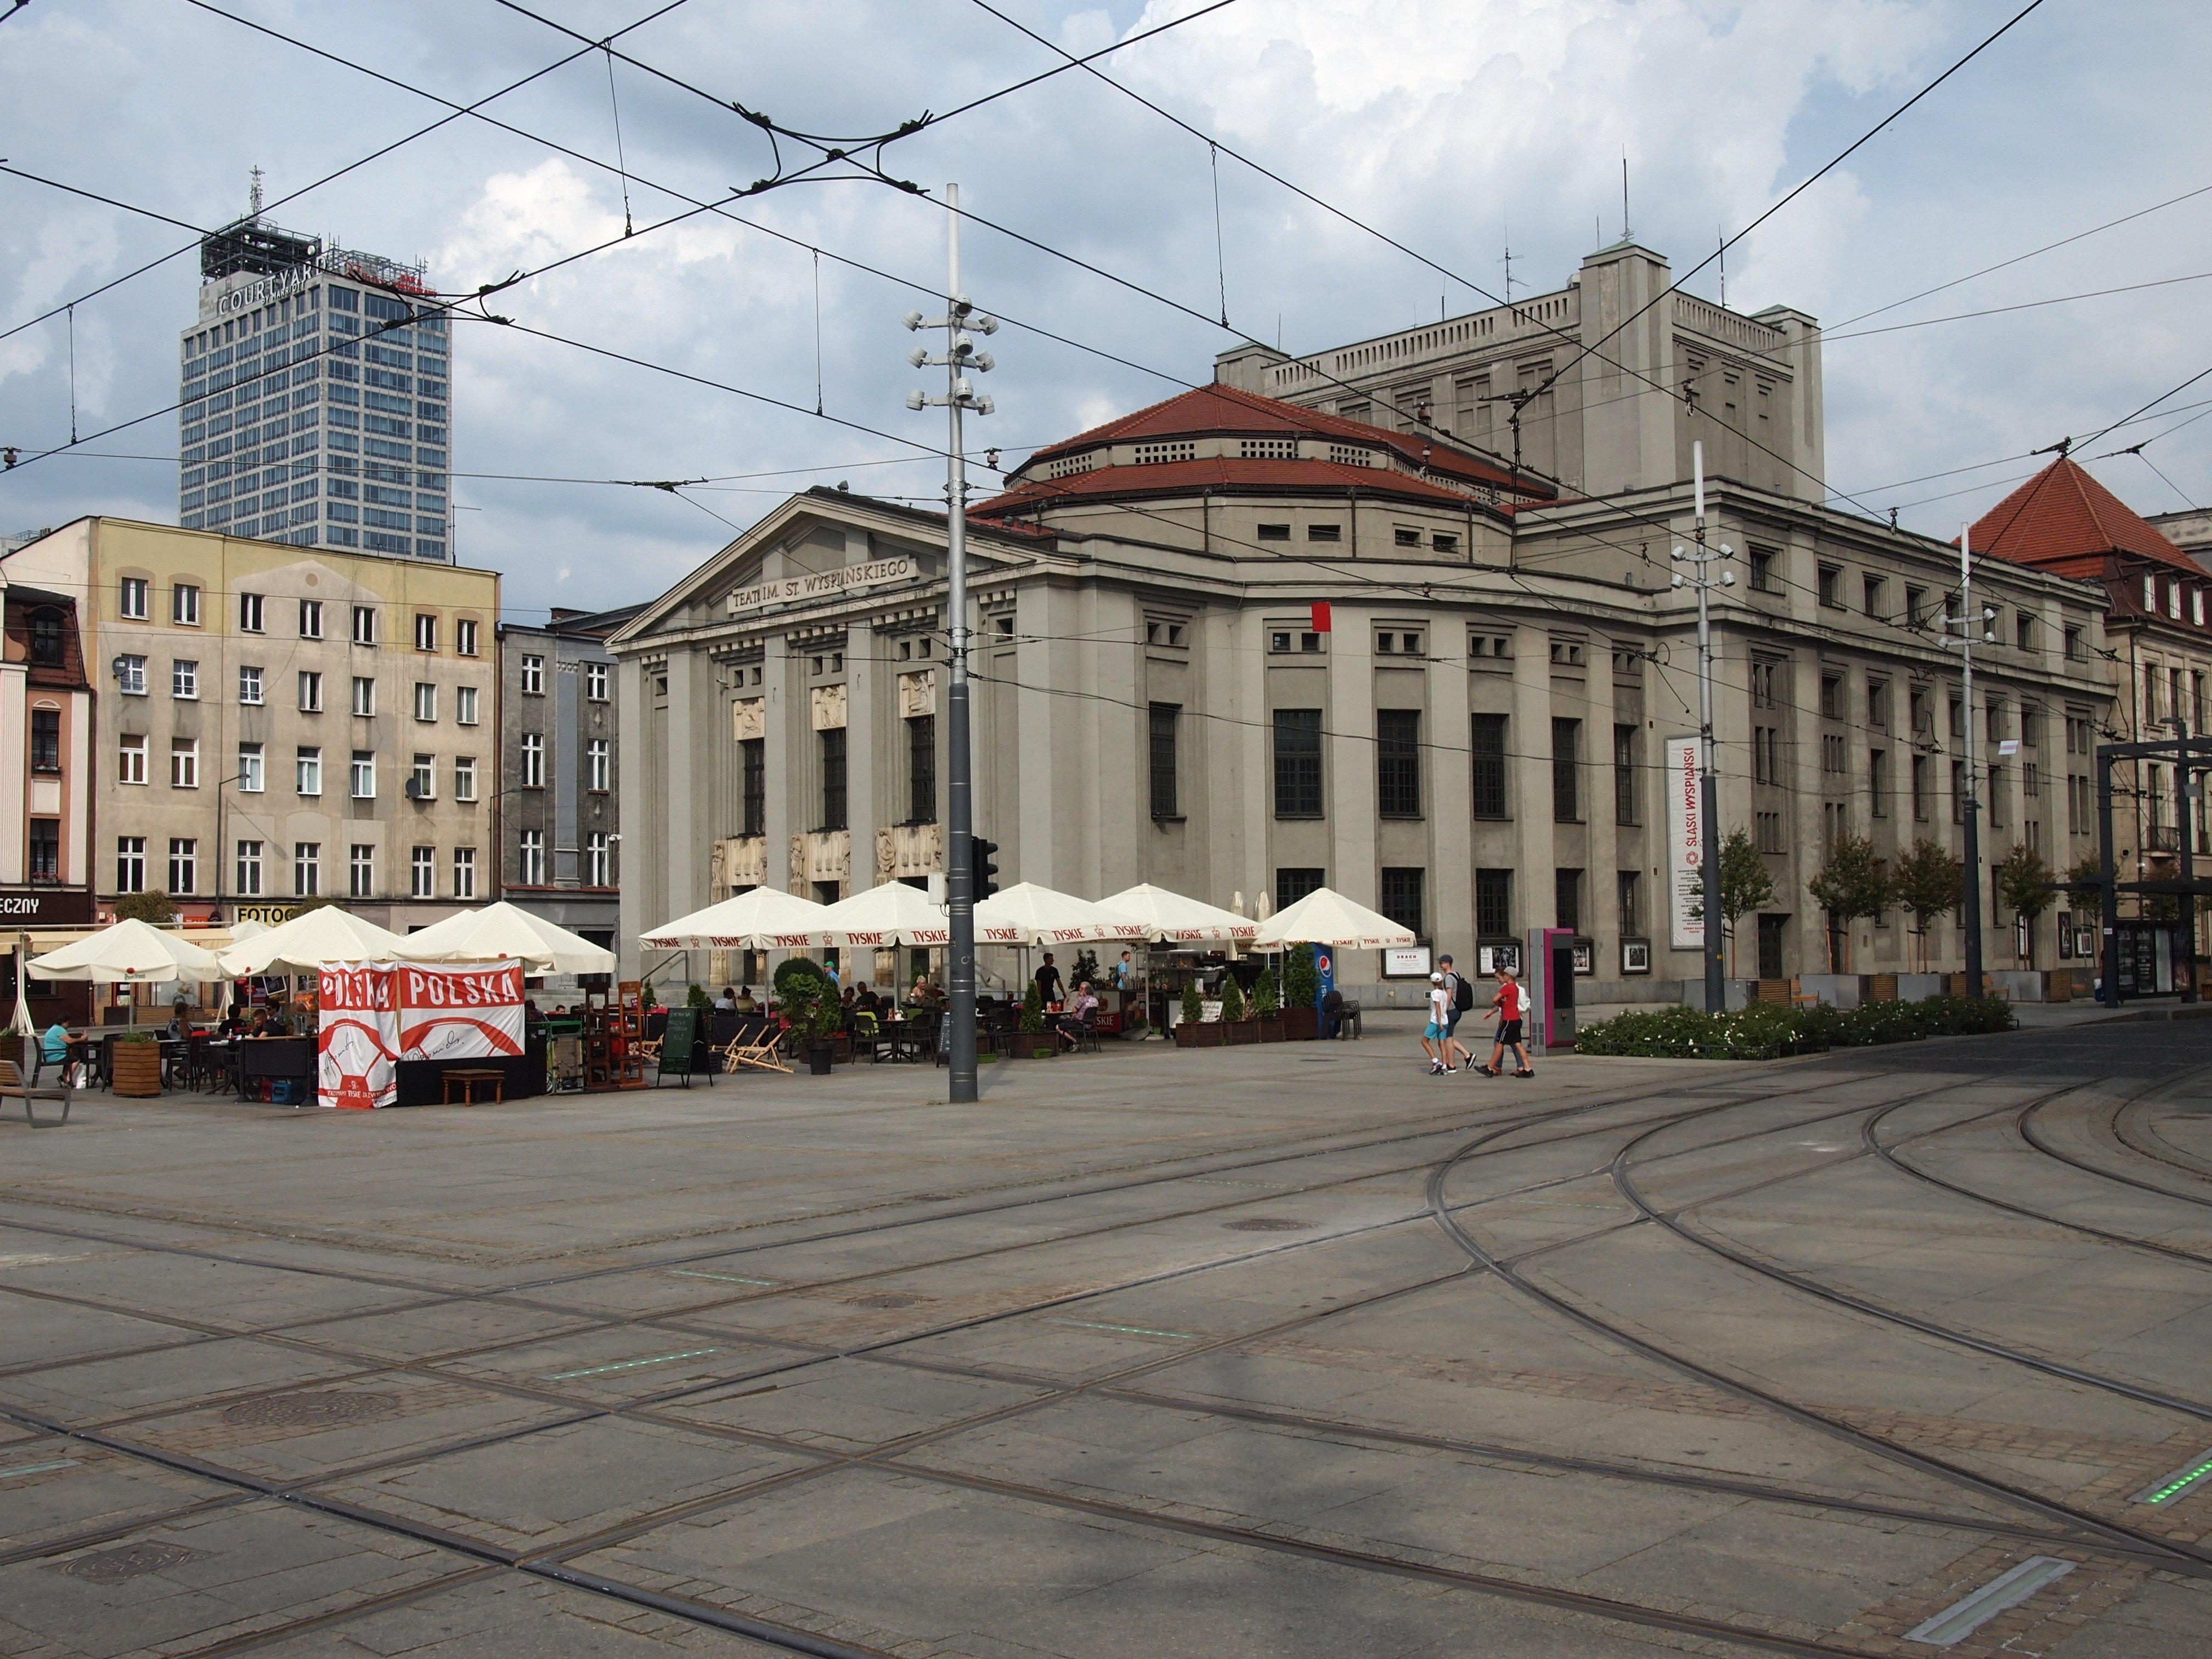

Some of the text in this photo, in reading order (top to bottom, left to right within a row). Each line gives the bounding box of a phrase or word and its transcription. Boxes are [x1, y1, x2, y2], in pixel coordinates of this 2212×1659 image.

[219, 252, 328, 315] COURTYARD
[262, 281, 305, 304] BY MARRIOTT
[763, 584, 779, 600] IM.
[786, 582, 800, 596] ST.
[804, 559, 908, 592] WYSPIAŃSKIEGO
[1684, 747, 1698, 847] ŚLĄSKI WYSPIAŃSKI
[911, 930, 950, 943] TYSKIE
[983, 928, 1019, 940] TYSKIE
[1051, 928, 1085, 941] TYSKIE
[1113, 925, 1143, 936] TYSKIE
[1228, 926, 1255, 938] TYSKIE
[650, 937, 681, 948] TYSKIE
[709, 936, 741, 947] TYSKIE
[774, 934, 810, 947] TYSKIE
[846, 932, 883, 945] TYSKIE
[322, 973, 390, 1008] POLSKA
[409, 971, 520, 1006] POLSKA
